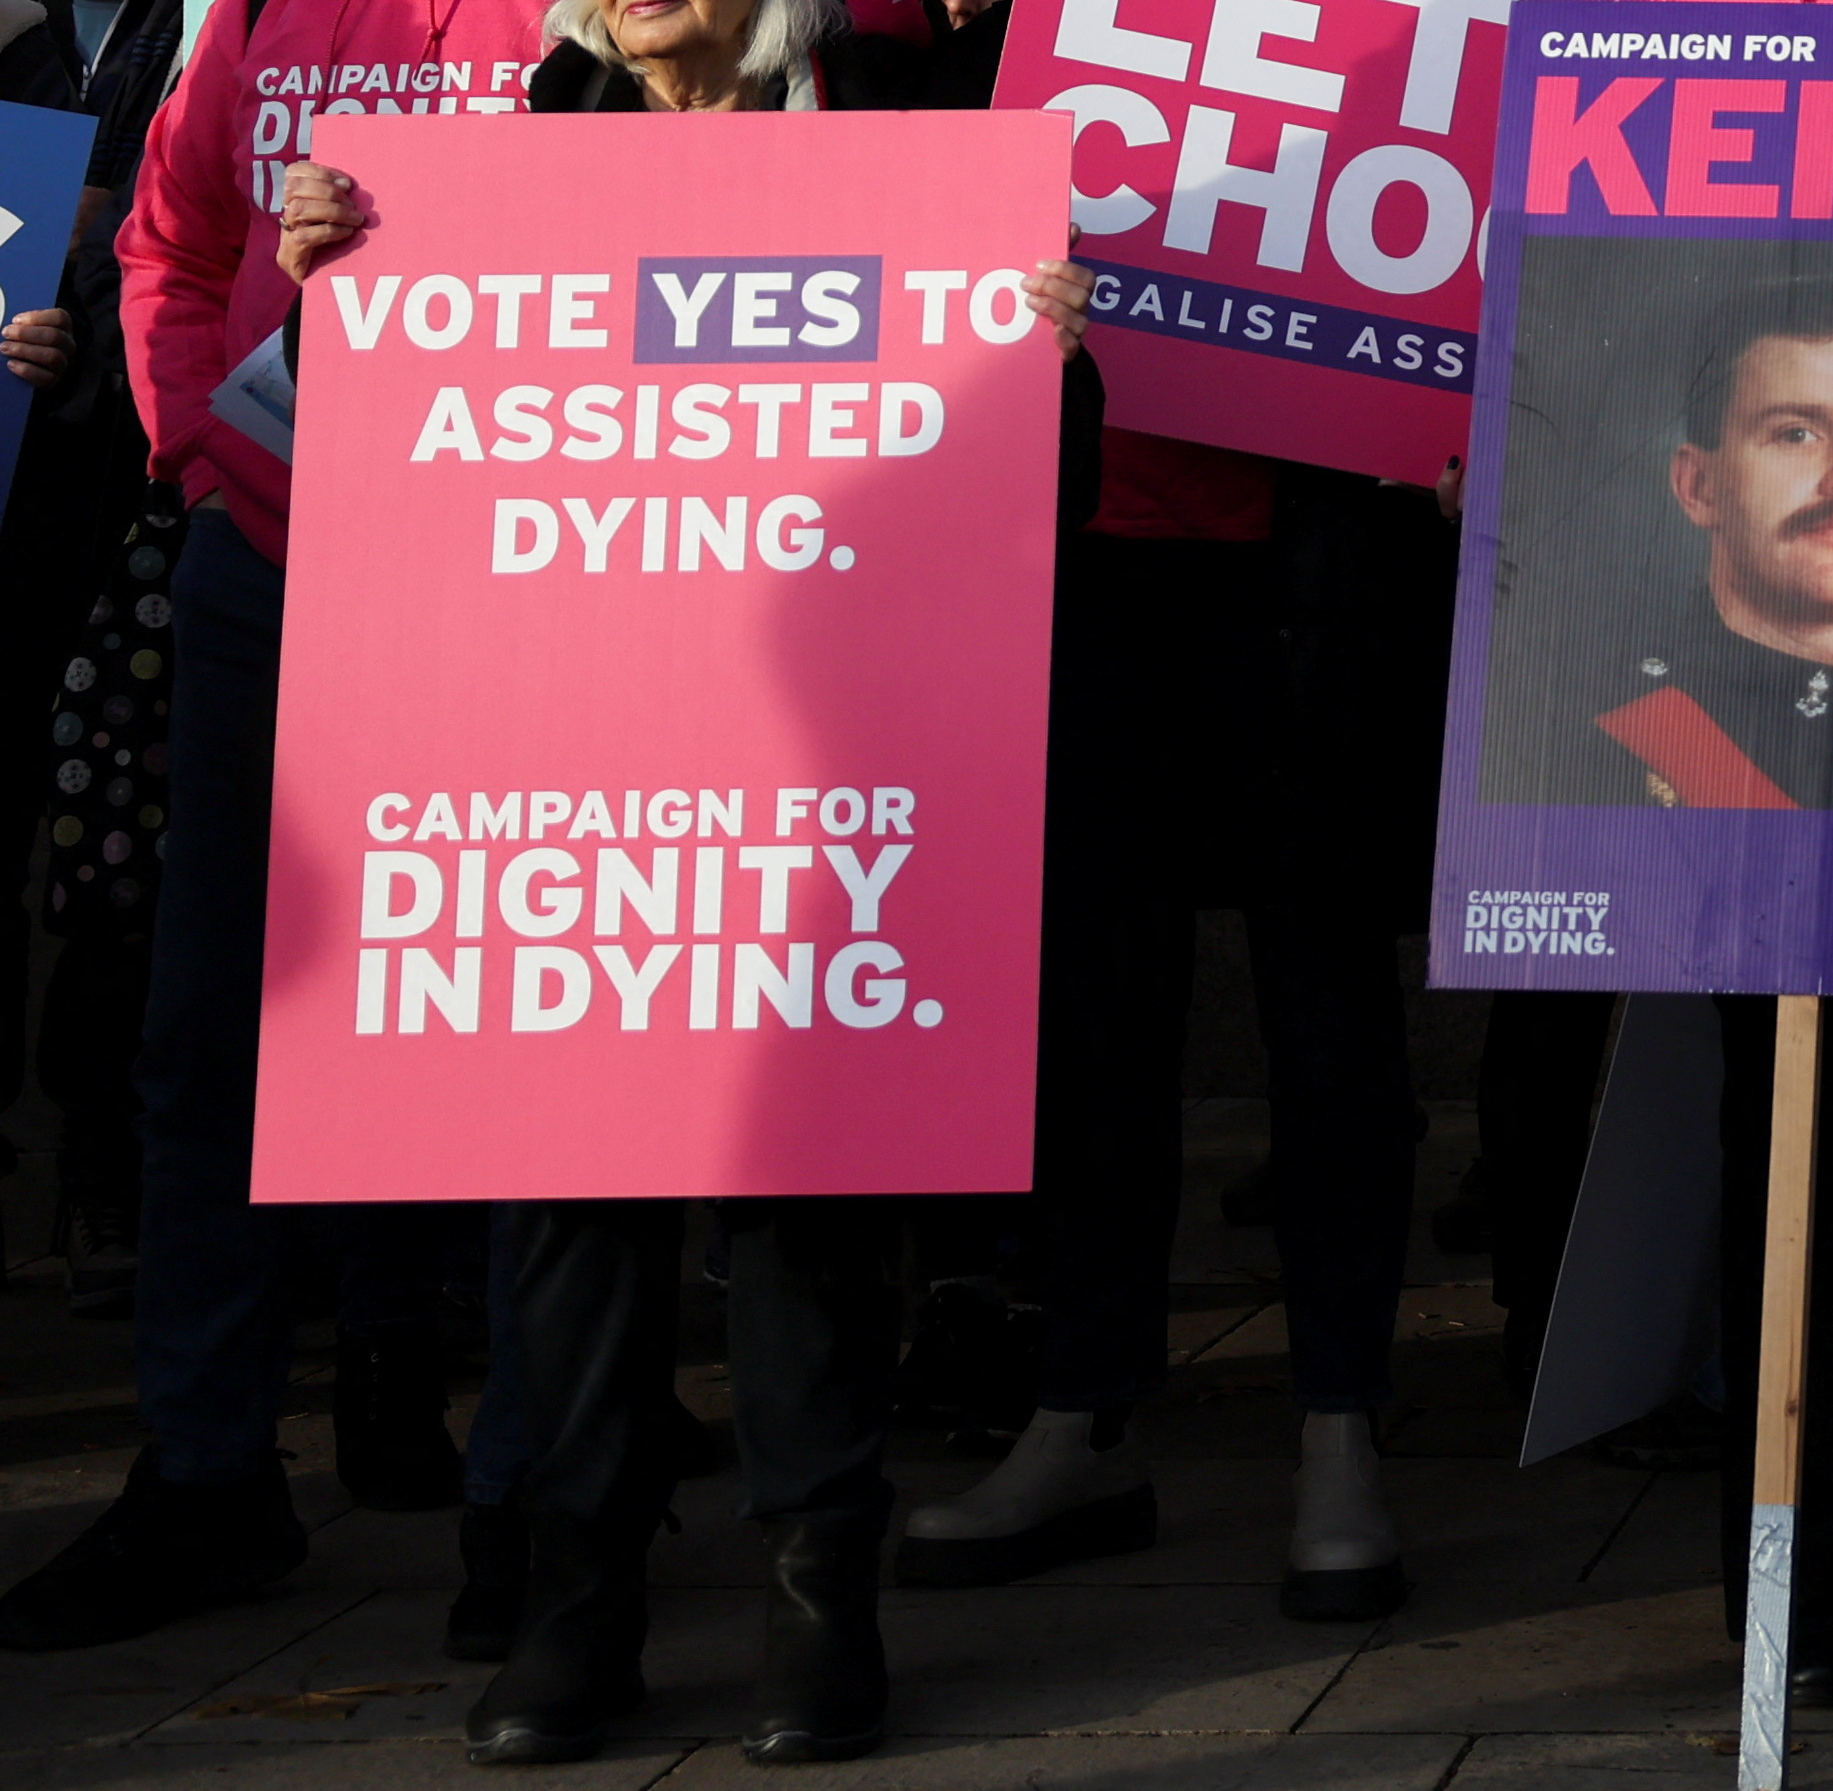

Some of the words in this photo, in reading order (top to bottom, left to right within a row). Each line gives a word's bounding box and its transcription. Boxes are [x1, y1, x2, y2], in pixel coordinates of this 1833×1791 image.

[256, 61, 472, 98] CAMPAIGN
[1540, 31, 1732, 60] CAMPAIGN
[1743, 35, 1816, 62] FOR
[1040, 83, 1490, 294] CHO
[331, 275, 609, 351] VOTE
[654, 271, 862, 349] YES
[904, 269, 1041, 344] TO
[1091, 274, 1317, 350] GALISE
[409, 382, 946, 464] ASSISTED
[491, 493, 856, 575] DYING.
[366, 788, 743, 844] CAMPAIGN
[775, 786, 916, 839] FOR
[361, 844, 914, 940] DIGNITY
[1466, 905, 1609, 930] DIGNITY
[1468, 890, 1566, 905] CAMPAIGN
[1573, 892, 1610, 906] FOR
[1464, 930, 1497, 953] IN
[1504, 931, 1615, 955] DYING.
[355, 945, 482, 1036] IN
[511, 940, 945, 1035] DYING.
